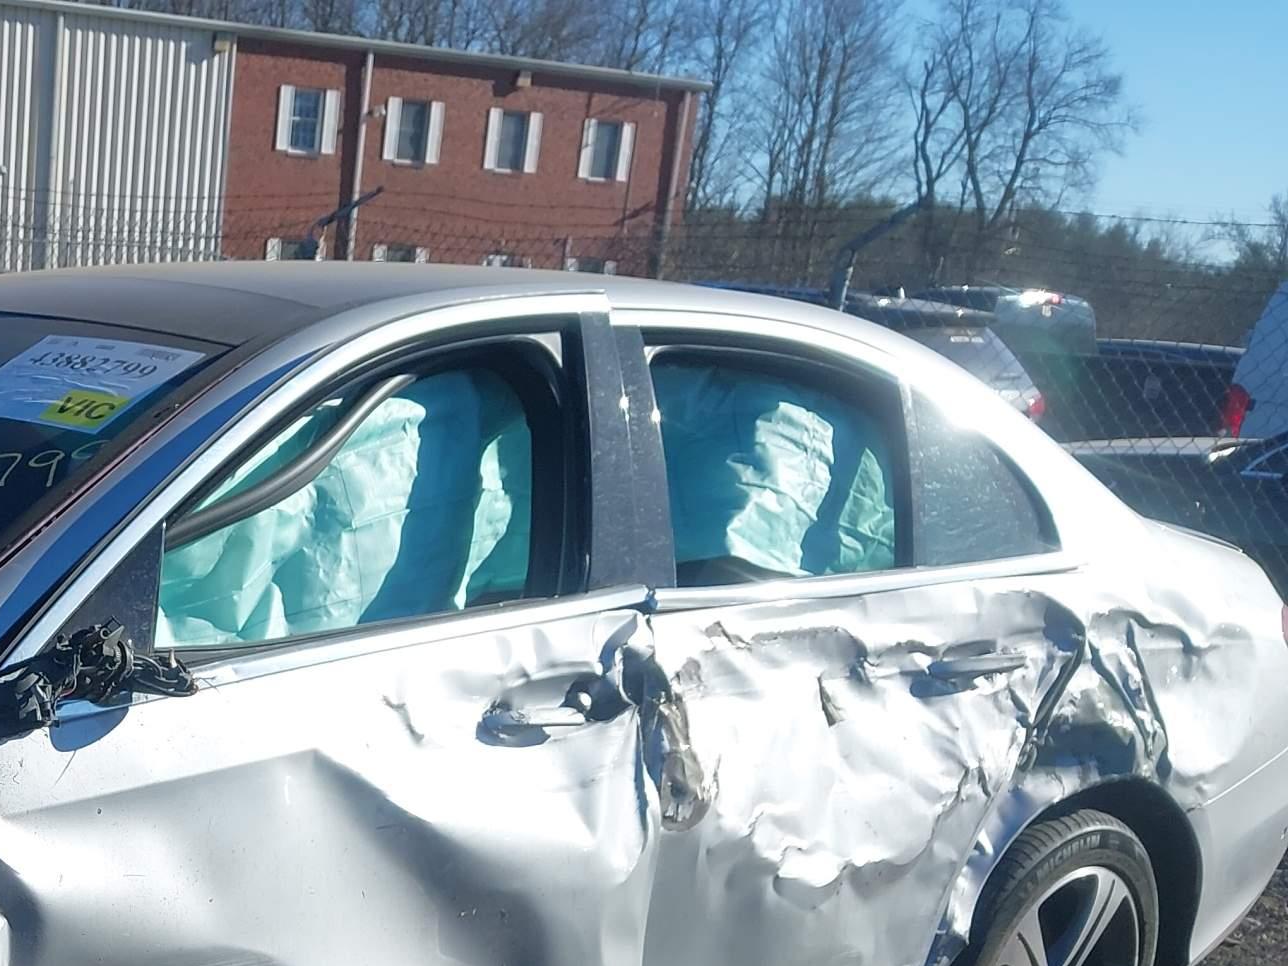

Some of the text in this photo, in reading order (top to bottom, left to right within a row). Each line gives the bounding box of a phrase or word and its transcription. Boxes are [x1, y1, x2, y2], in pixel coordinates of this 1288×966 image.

[28, 351, 158, 379] 43882799
[56, 395, 117, 421] VIC
[1037, 833, 1102, 880] MICHELIN
